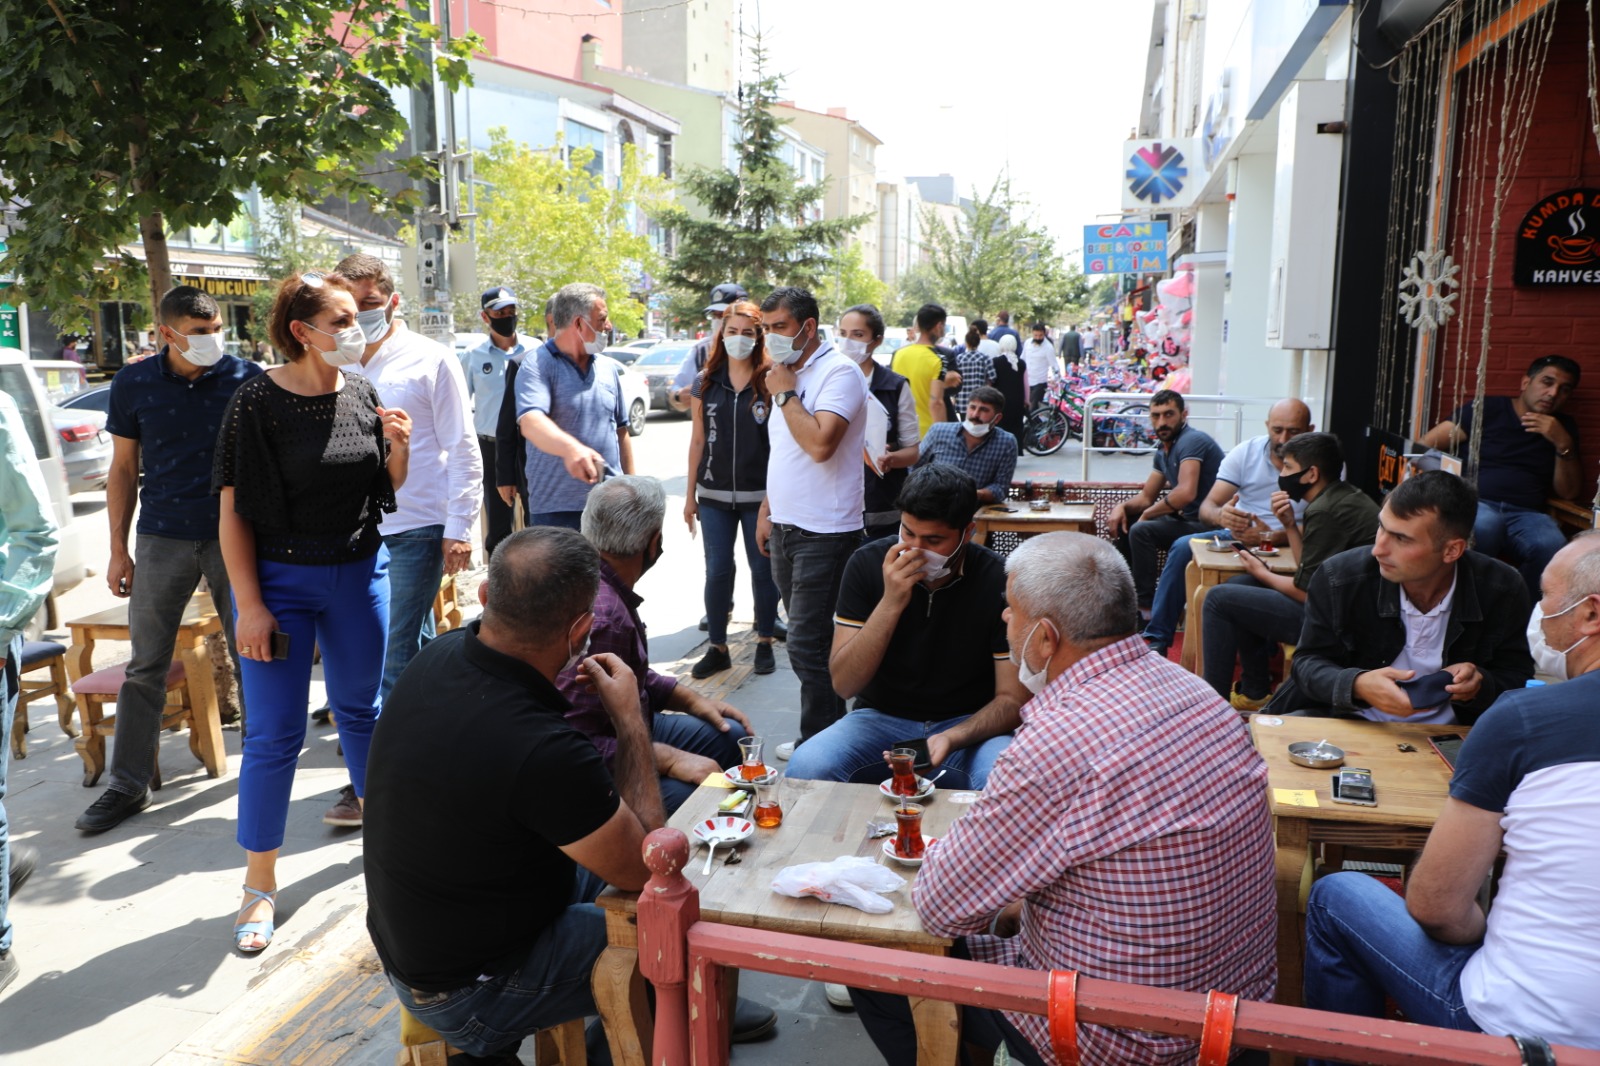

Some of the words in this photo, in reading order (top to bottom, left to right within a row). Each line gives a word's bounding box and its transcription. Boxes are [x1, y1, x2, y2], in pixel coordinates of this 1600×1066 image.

[1522, 192, 1584, 239] KUMDA
[1098, 224, 1152, 238] CAN
[1088, 243, 1113, 254] BEBE
[1115, 242, 1124, 253] &
[1126, 240, 1164, 255] ÇOCUK
[1090, 255, 1161, 272] GİYİM
